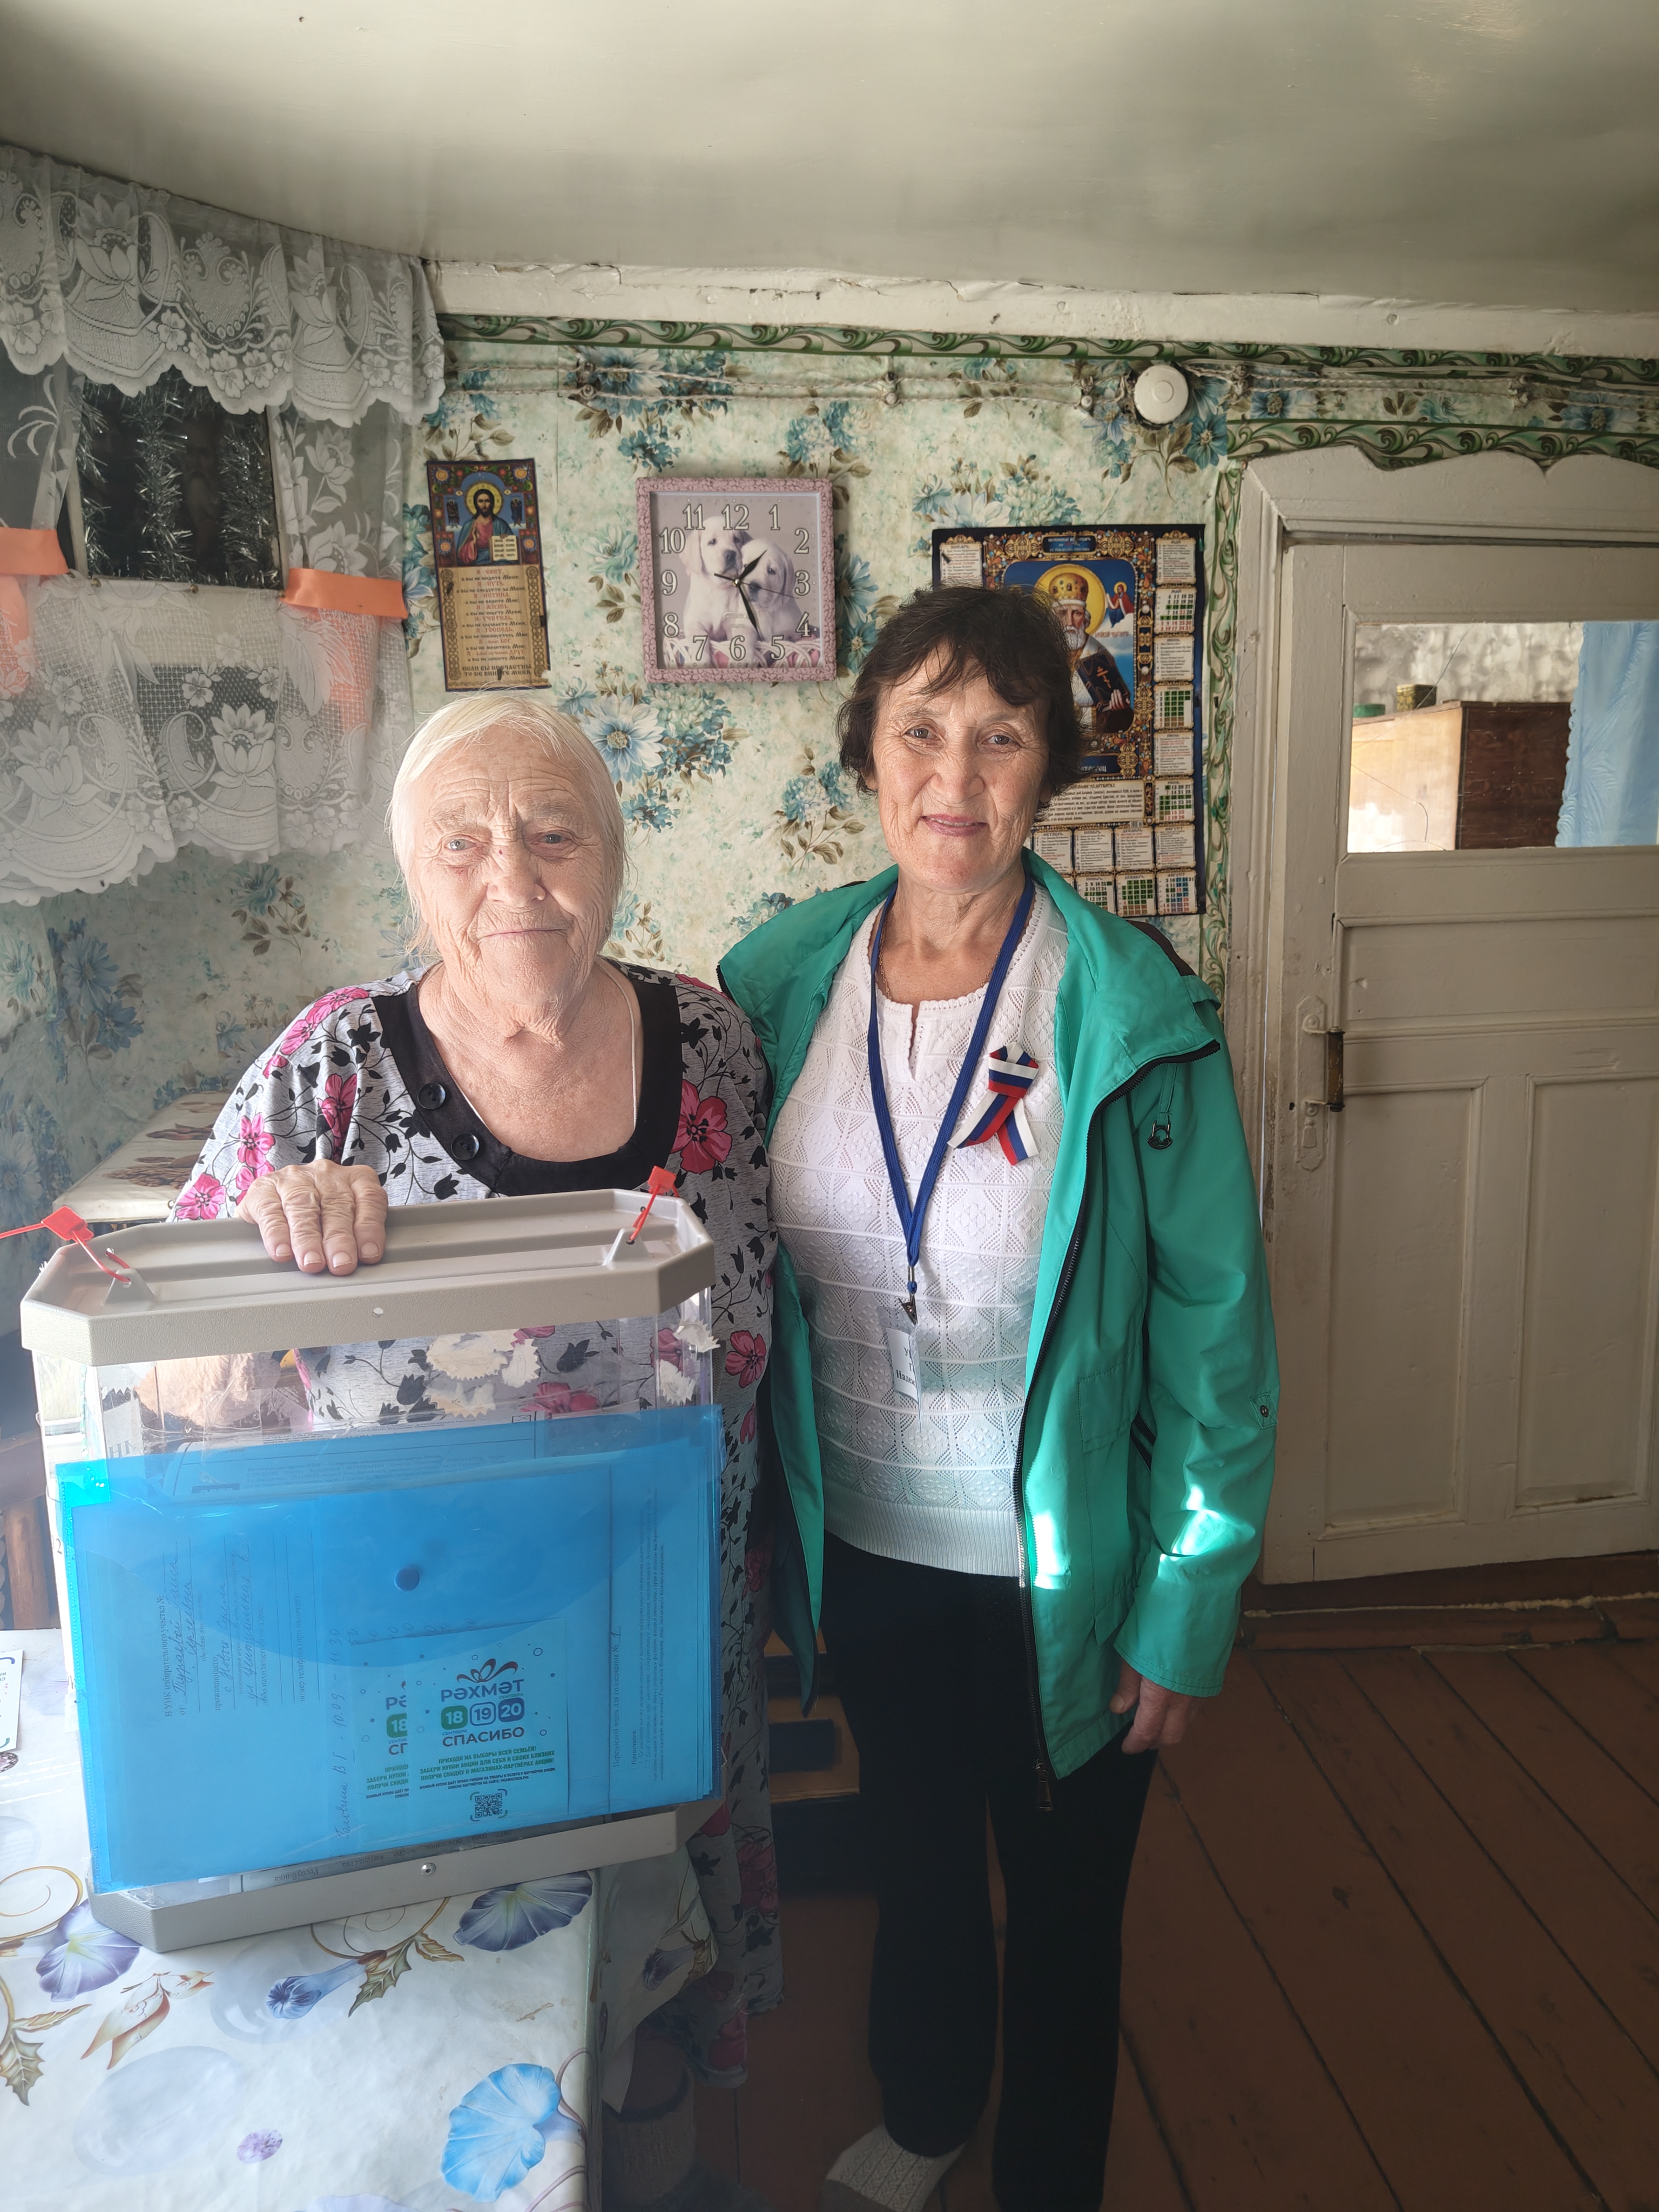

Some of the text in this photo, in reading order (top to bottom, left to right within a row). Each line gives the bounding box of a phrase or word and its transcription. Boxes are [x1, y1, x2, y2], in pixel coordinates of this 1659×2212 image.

[683, 504, 705, 530] 11
[721, 504, 750, 530] 12
[769, 504, 781, 530] 1
[660, 528, 686, 554] 10
[794, 528, 810, 554] 2
[661, 570, 678, 595] 9
[794, 570, 810, 596] 3
[663, 612, 679, 637] 8
[796, 612, 811, 637] 4
[693, 635, 708, 661] 7
[730, 636, 746, 660] 6
[771, 636, 785, 660] 5
[895, 1369, 916, 1387] Надеж
[441, 1679, 524, 1702] РӘХМӘТ
[446, 1703, 522, 1724] 18 19 20
[442, 1727, 524, 1747] СПАСИБО
[473, 1751, 497, 1759] ВЫБОРЫ
[420, 1766, 441, 1774] ЗАБЕРИ
[421, 1773, 442, 1781] ПОЛУЧИ
[443, 1770, 464, 1778] СКИДКУ
[390, 1778, 409, 1787] СКИДК
